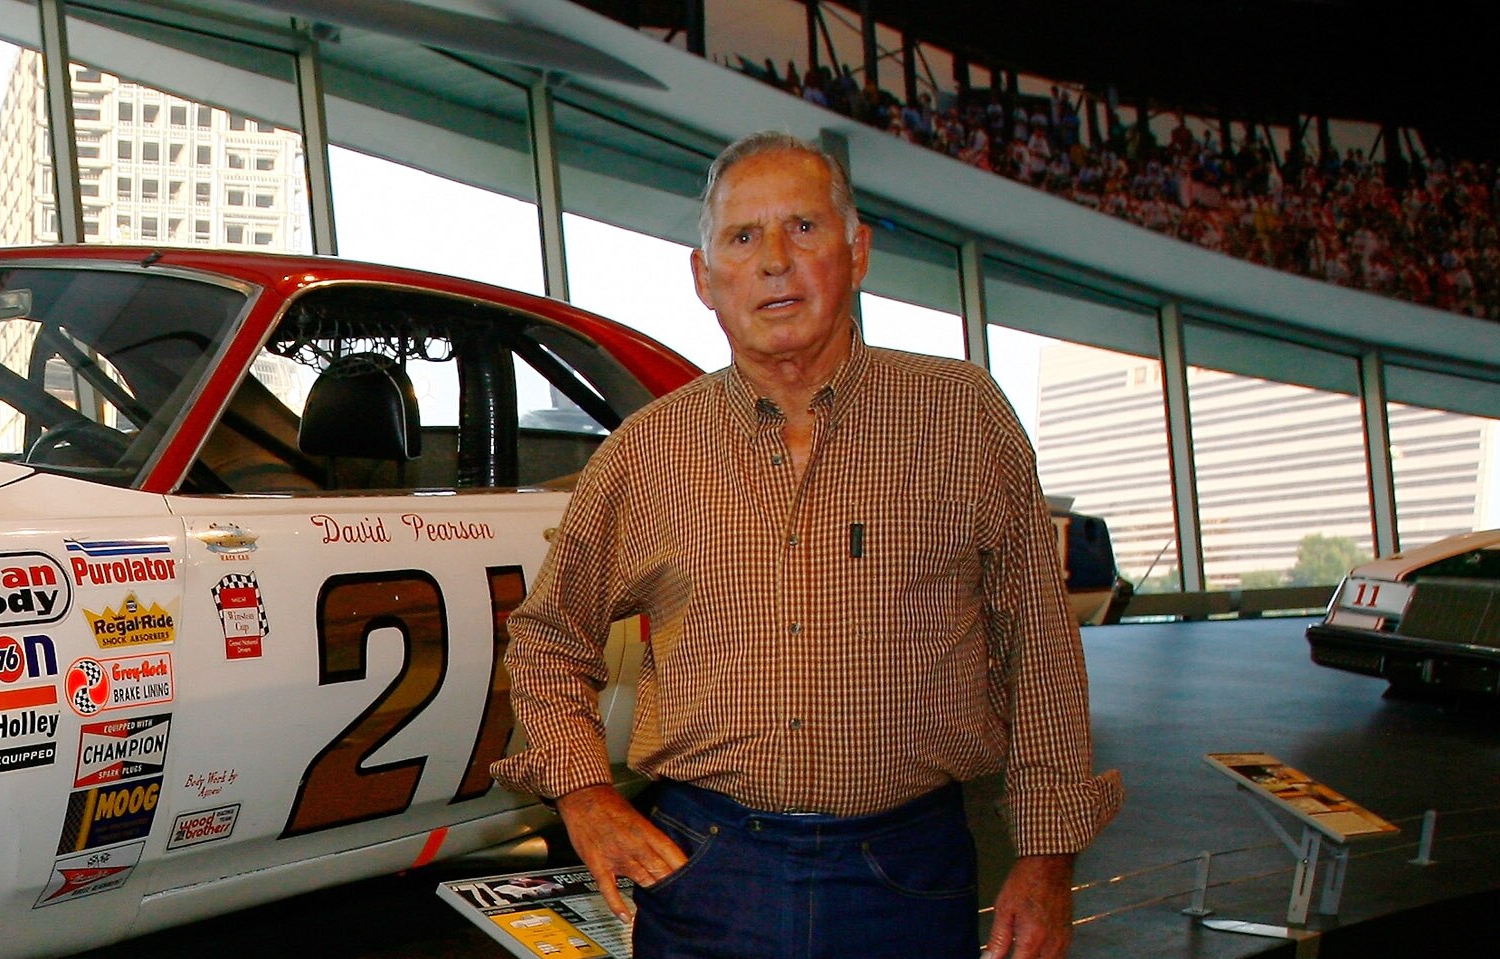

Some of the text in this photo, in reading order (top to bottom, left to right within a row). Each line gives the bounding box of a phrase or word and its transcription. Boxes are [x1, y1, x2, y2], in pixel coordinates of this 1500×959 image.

[311, 513, 495, 544] David Pearson
[71, 557, 176, 586] Purolator
[1353, 583, 1381, 607] 11
[235, 622, 250, 634] Cup
[102, 631, 169, 646] SHOCK ABSORBERS
[114, 683, 169, 702] BRAKE LINING
[104, 719, 153, 733] EQUIPPED WITH
[83, 734, 165, 764] CHAMPION
[99, 765, 142, 779] SPARK PLUGS
[94, 783, 160, 820] MOOG
[180, 812, 215, 830] wood
[185, 823, 230, 839] brothers
